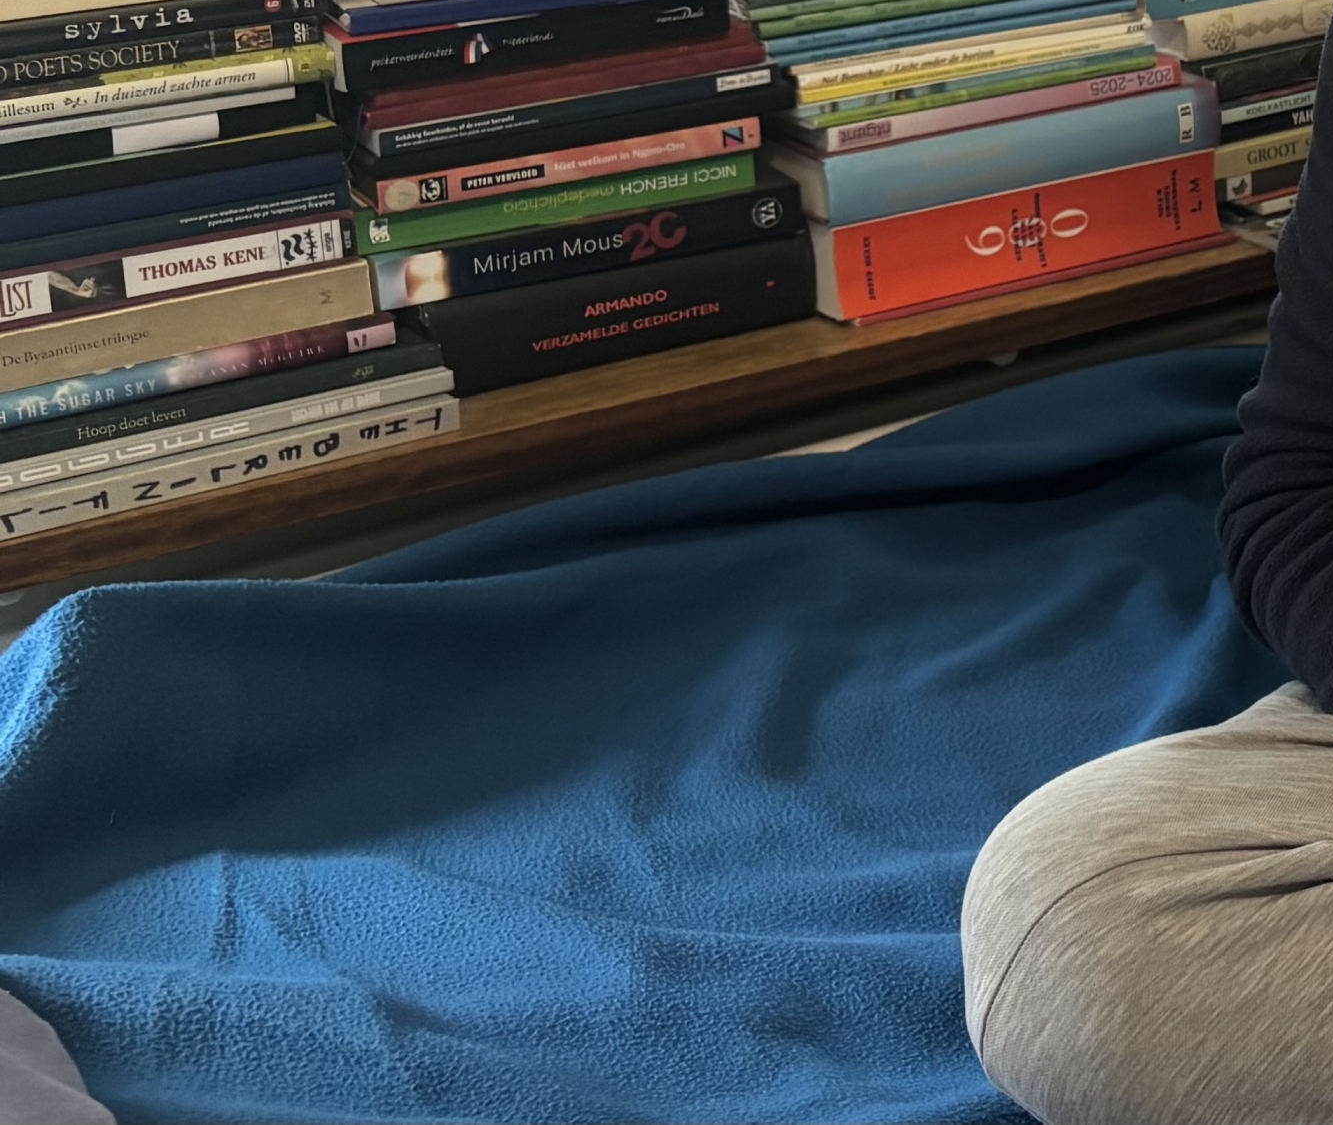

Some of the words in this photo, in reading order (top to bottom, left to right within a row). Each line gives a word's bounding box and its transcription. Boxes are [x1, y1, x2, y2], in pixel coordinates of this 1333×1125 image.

[64, 7, 194, 41] sylvia
[13, 53, 82, 82] POETS
[88, 39, 181, 70] SOCIETY
[94, 90, 108, 105] In
[111, 84, 167, 105] duizend
[169, 77, 212, 95] zachte
[214, 70, 258, 86] armen
[1089, 67, 1172, 97] 2024-2025
[838, 120, 892, 143] ntgent
[466, 174, 495, 189] PETER
[619, 172, 689, 197] FRENCH
[692, 164, 737, 185] NICCI
[138, 254, 218, 282] THOMAS
[472, 245, 554, 277] Mirjam
[562, 231, 625, 258] Mous
[583, 288, 669, 319] ARMANDO
[532, 321, 630, 352] VERZAMELDE
[632, 301, 720, 331] GEDICHTEN
[2, 354, 22, 368] De
[24, 337, 101, 366] Byzantijnse
[102, 328, 150, 348] trilogie
[15, 394, 50, 420] THE
[57, 384, 118, 412] SUGAR
[124, 378, 158, 400] SKY
[76, 421, 117, 442] Hoop
[118, 416, 150, 432] doet
[151, 406, 187, 425] leven
